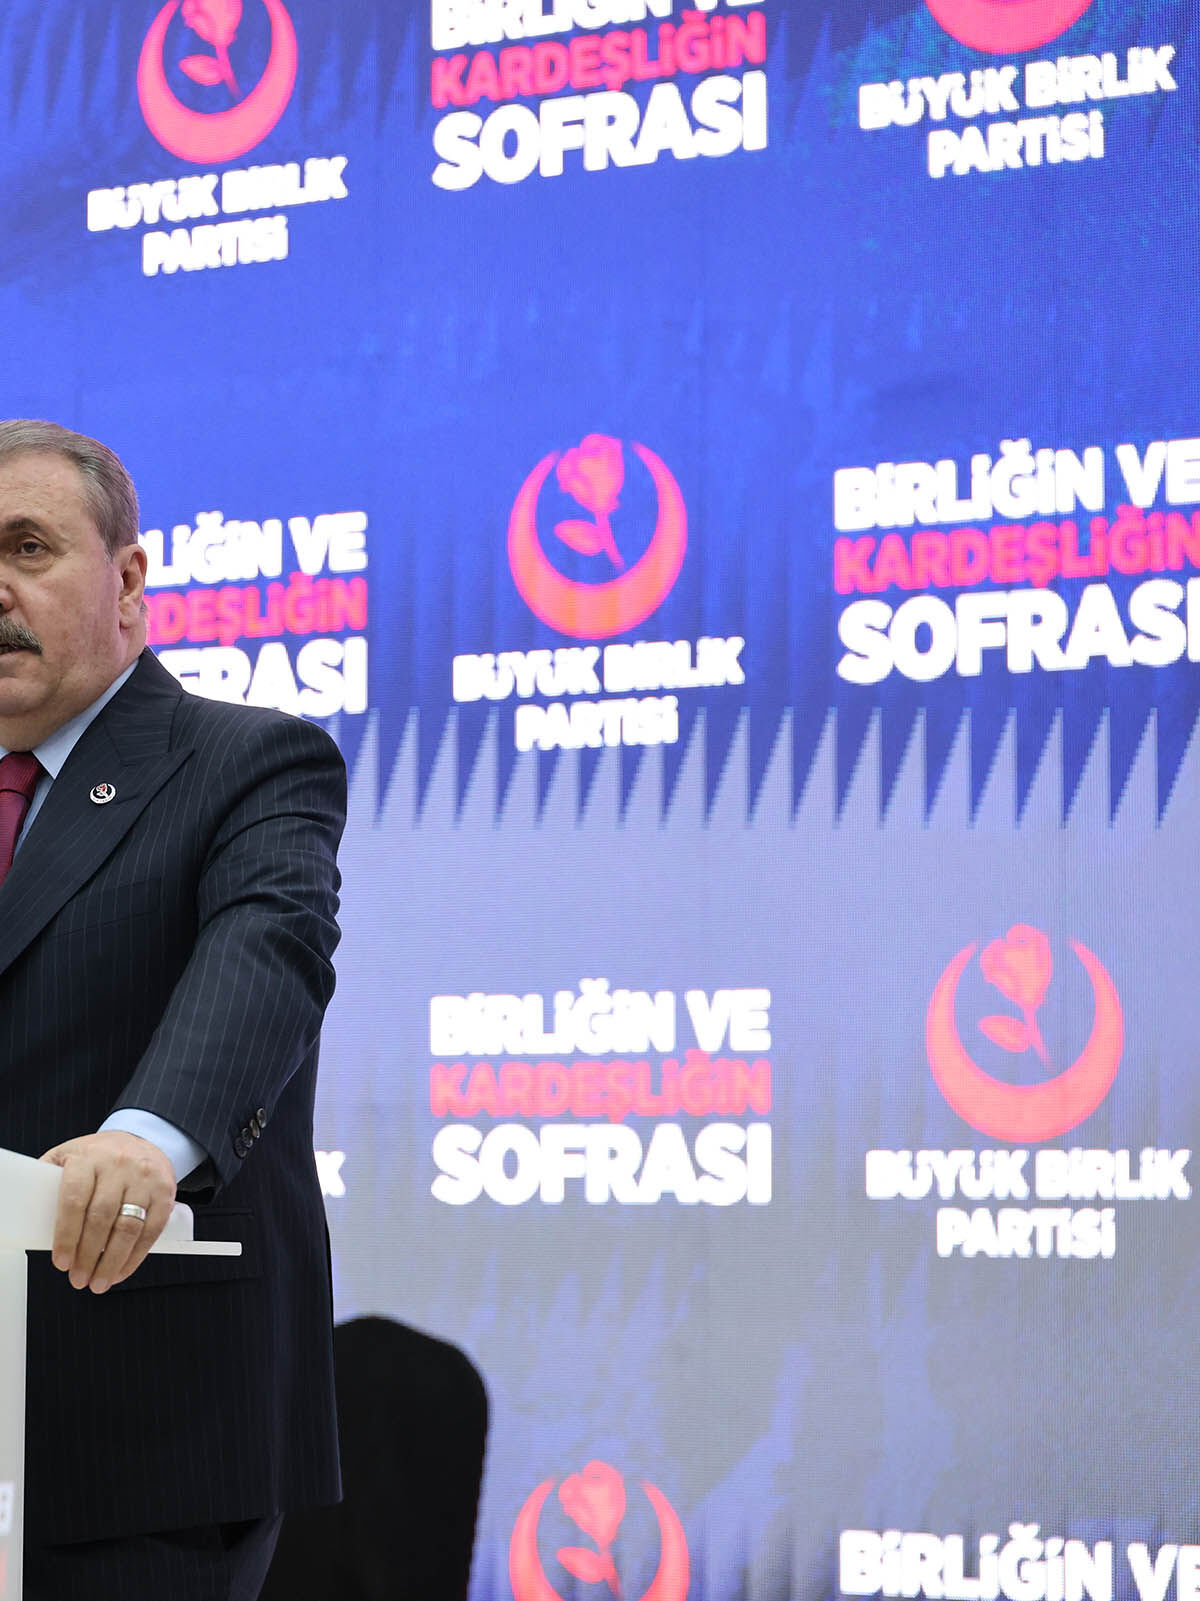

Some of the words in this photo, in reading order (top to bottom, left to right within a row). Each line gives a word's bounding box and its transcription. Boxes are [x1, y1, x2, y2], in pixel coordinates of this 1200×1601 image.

[431, 0, 671, 50] BİRL
[431, 9, 766, 109] KARDEŞLİĞİN
[859, 67, 1019, 130] BÜYÜK
[1025, 45, 1177, 107] BİRLİK
[432, 71, 767, 190] SOFRASI
[928, 111, 1104, 178] PARTİSİ
[834, 438, 1104, 531] BİRLİĞİN
[1116, 438, 1200, 508] VE
[139, 511, 282, 587] LİĞİN
[288, 511, 367, 575] VE
[834, 504, 1200, 595] KARDEŞLİĞİN
[144, 572, 367, 648] DEŞLİĞİN
[836, 577, 1200, 685] SOFRASI
[157, 636, 367, 717] FRASI
[430, 977, 676, 1056] BİRLİĞİN
[684, 988, 772, 1052] VE
[429, 1048, 772, 1124] KARDEŞLİĞİN
[430, 1122, 772, 1206] SOFRASI
[866, 1149, 1029, 1200] BÜYÜK
[1035, 1148, 1191, 1199] BİRLİK
[936, 1207, 1116, 1259] PARTİSİ
[839, 1523, 1113, 1601] BİRLİĞİN
